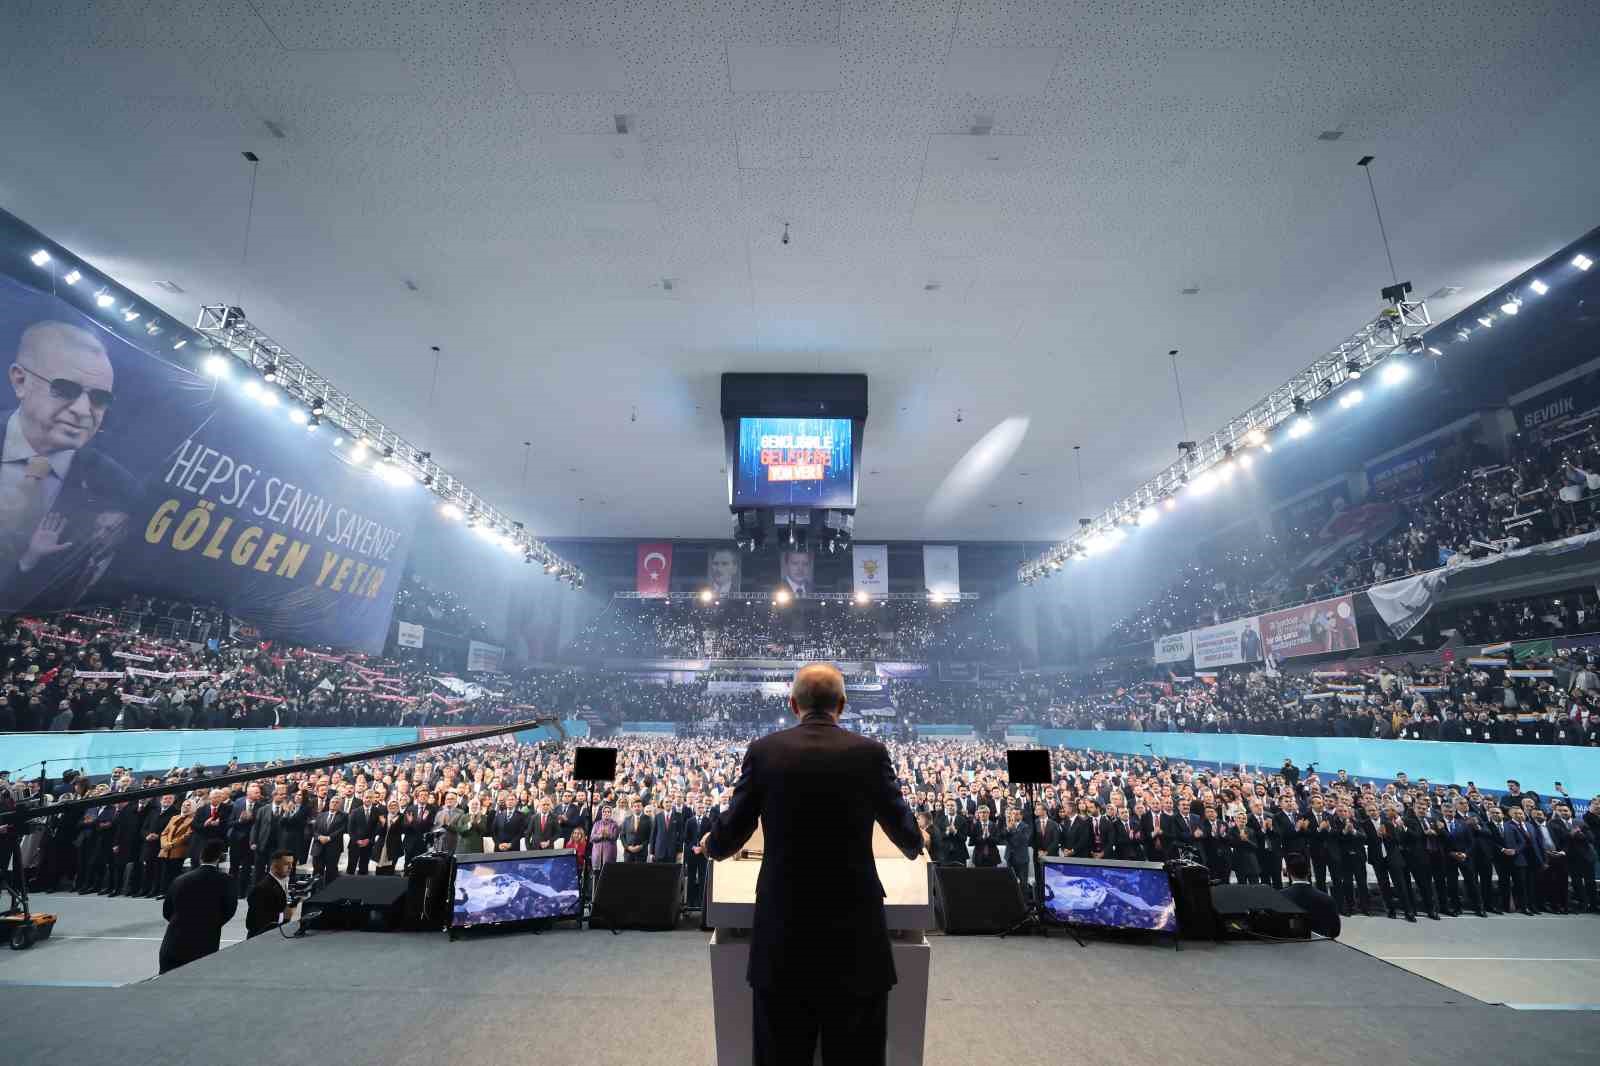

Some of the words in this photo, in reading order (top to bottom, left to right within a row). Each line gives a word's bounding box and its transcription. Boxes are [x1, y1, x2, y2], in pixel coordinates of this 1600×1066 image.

[165, 439, 261, 508] HEPSİ
[253, 477, 331, 537] SENİN
[145, 498, 309, 579] GÖLGEN
